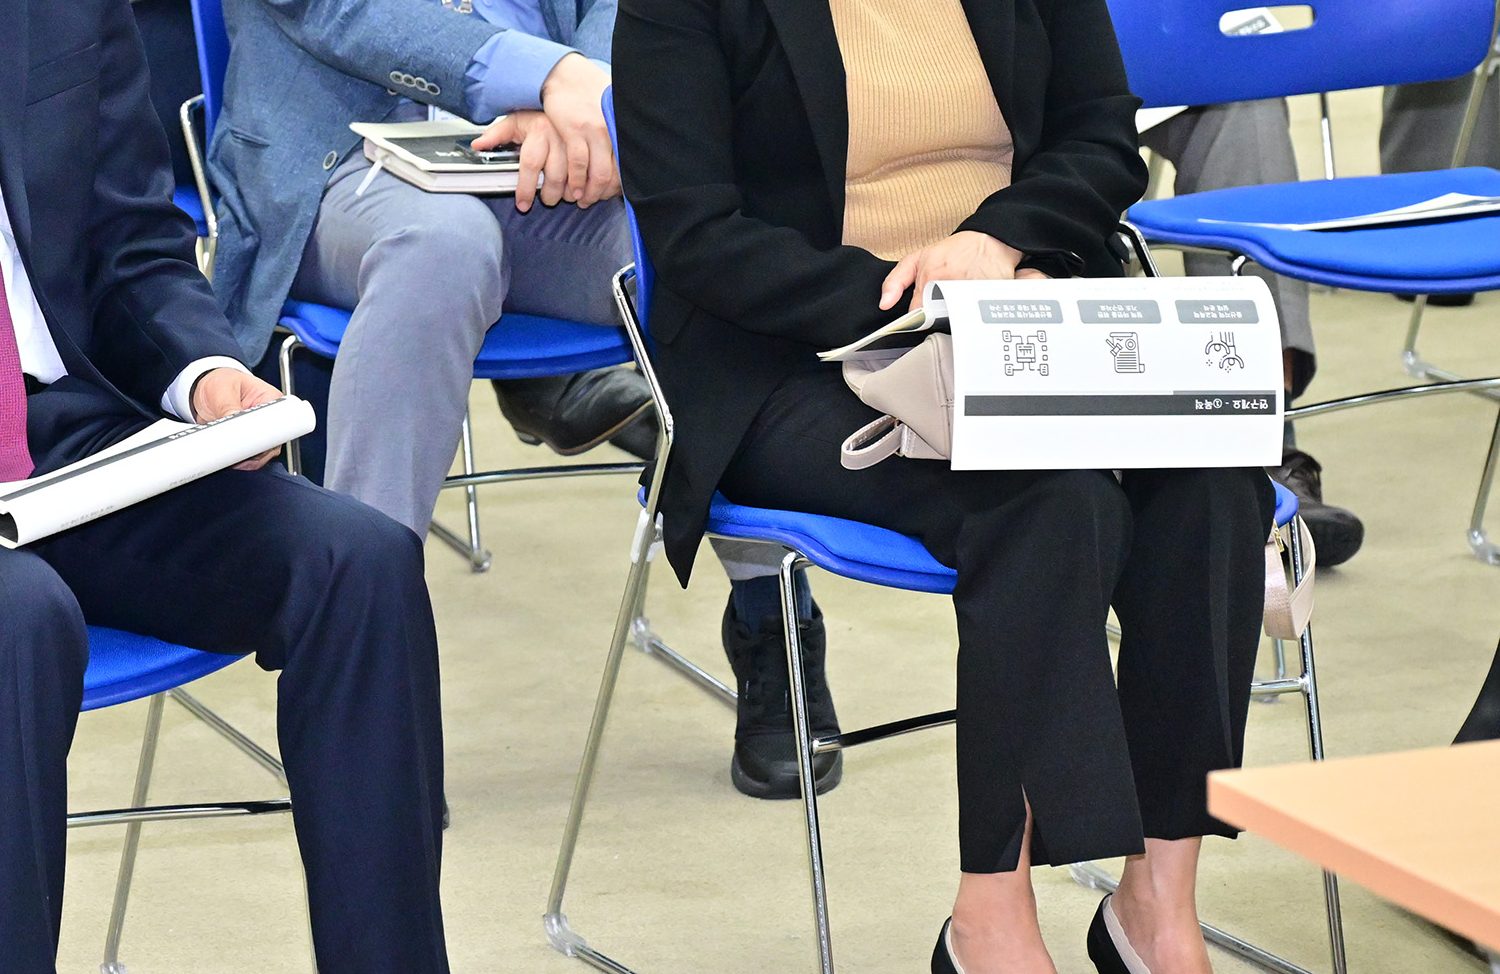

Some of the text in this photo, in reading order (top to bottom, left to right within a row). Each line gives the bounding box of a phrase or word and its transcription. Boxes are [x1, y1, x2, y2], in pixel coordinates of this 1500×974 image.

[1099, 304, 1124, 312] 연구자료
[990, 311, 1016, 319] 학교폭력
[1193, 311, 1243, 319] 울산지역 학교폭력
[1232, 399, 1269, 410] 연구개요
